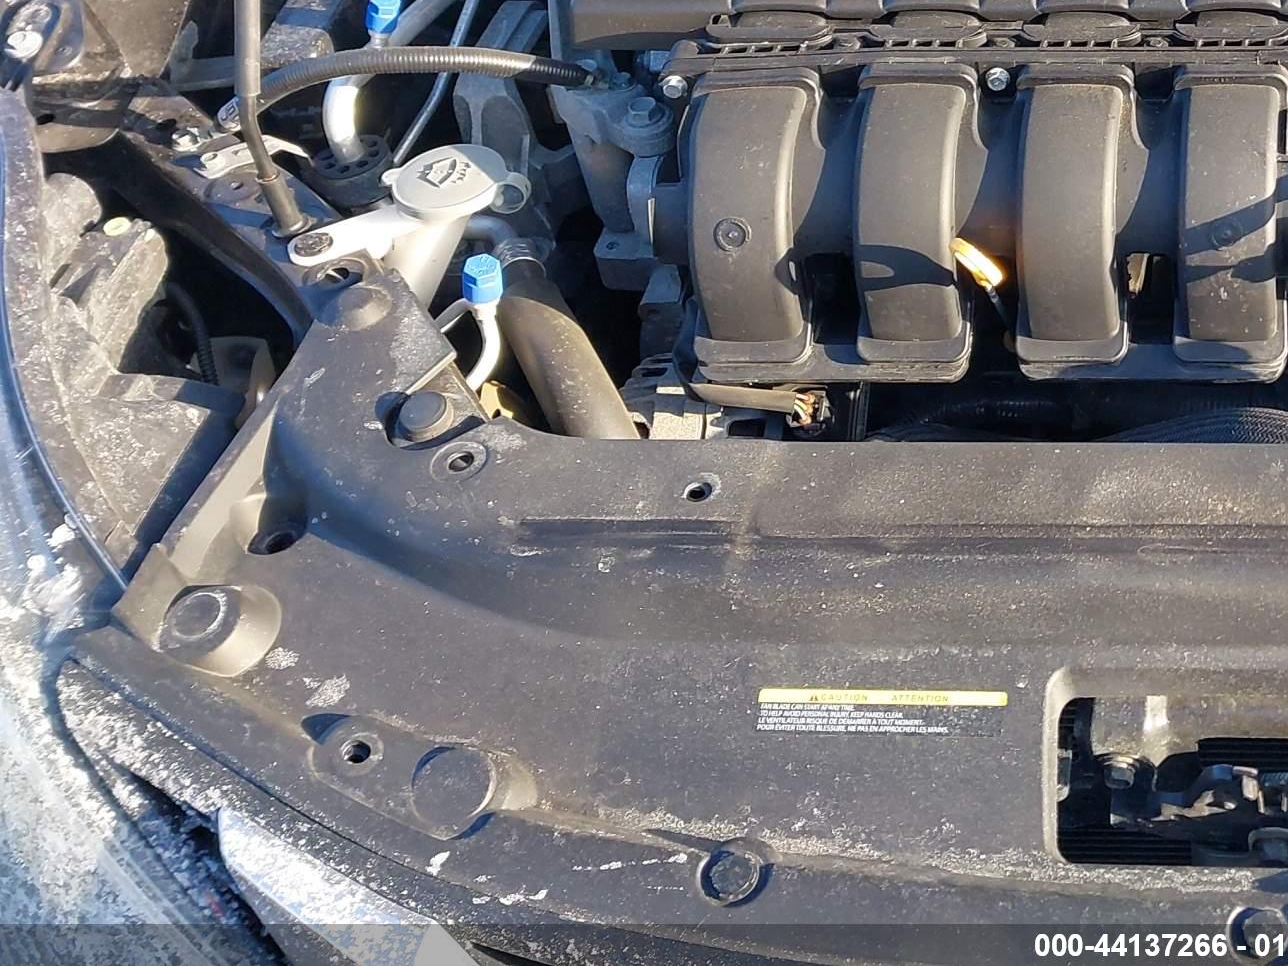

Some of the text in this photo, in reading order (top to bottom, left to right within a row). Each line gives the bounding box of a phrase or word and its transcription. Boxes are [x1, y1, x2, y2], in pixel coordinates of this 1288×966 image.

[820, 693, 950, 703] CAUTION ATTENTION
[878, 718, 895, 726] TOUT
